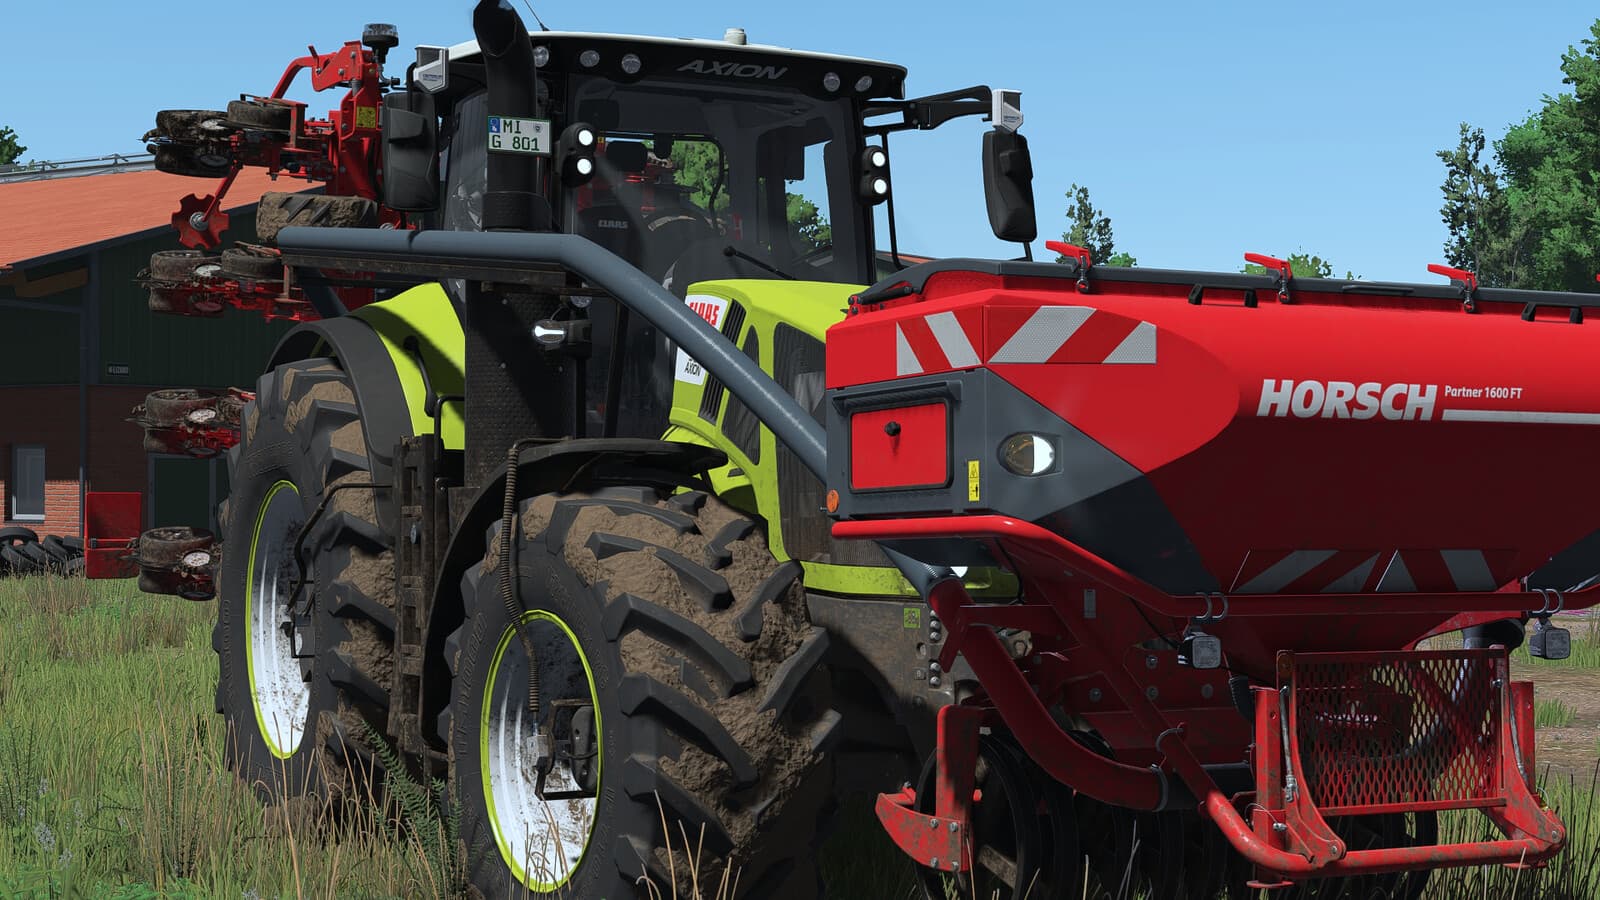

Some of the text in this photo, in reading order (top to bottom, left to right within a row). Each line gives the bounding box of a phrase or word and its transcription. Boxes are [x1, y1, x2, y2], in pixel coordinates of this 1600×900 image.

[676, 59, 788, 80] AXION
[503, 119, 522, 134] MI
[492, 134, 540, 151] G 801
[684, 361, 702, 377] AXION
[1256, 378, 1438, 421] HORSCH
[1444, 385, 1523, 399] Partner 1600 FT
